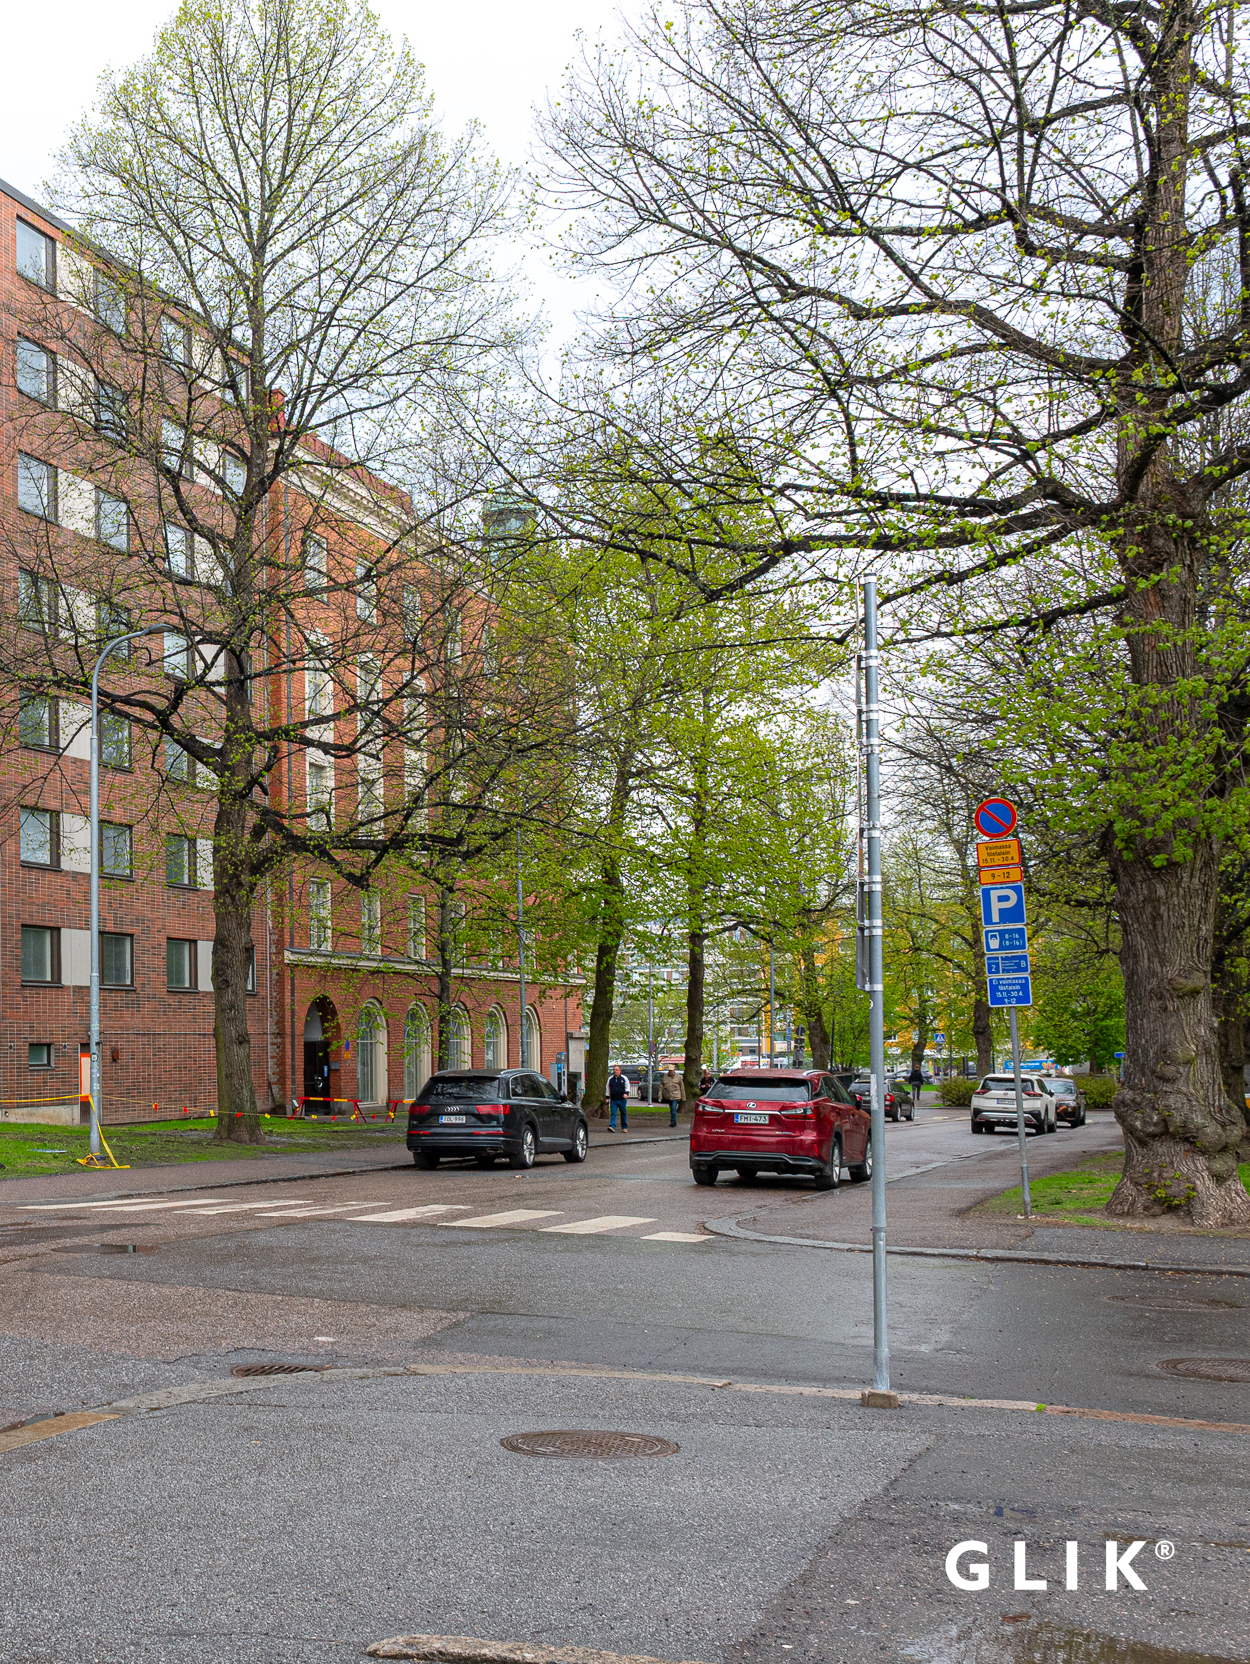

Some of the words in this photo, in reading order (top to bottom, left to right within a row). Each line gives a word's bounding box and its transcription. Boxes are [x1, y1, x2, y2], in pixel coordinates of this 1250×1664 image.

[990, 889, 1018, 923] P
[991, 964, 997, 972] 2
[1020, 960, 1027, 968] B
[739, 1114, 768, 1123] FMI-473
